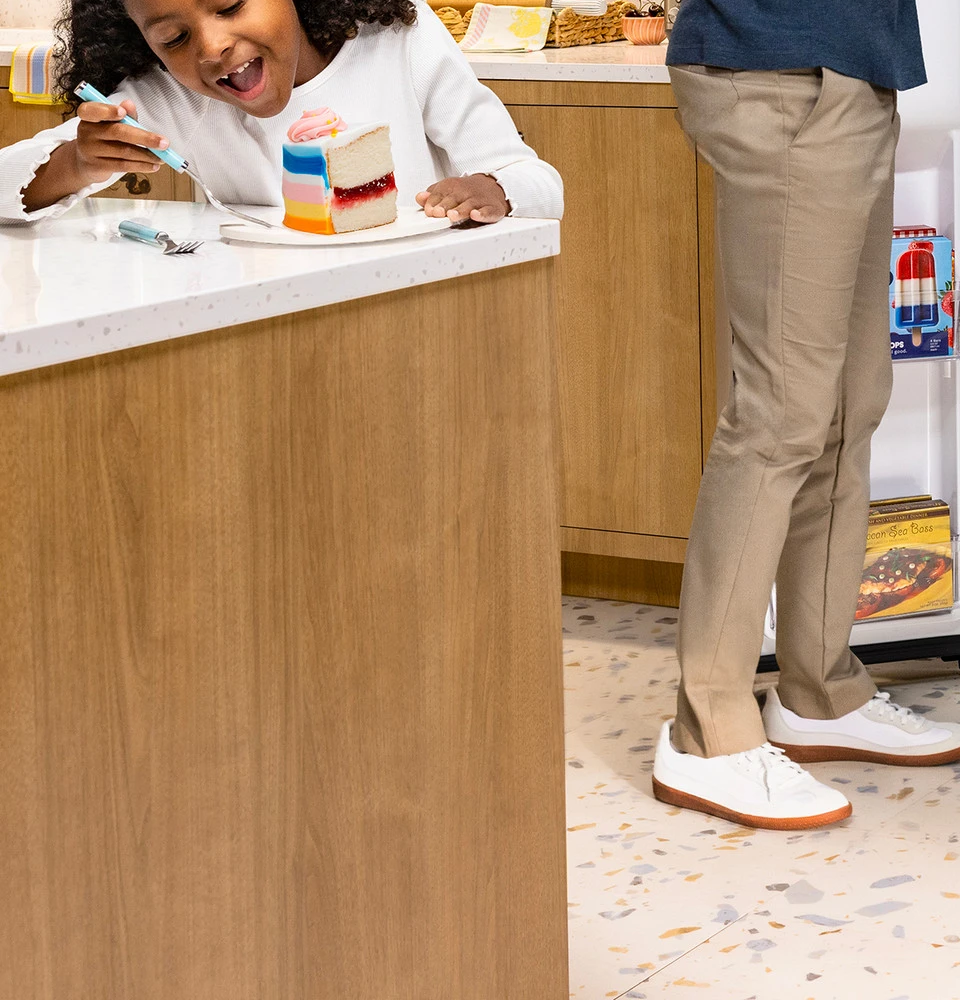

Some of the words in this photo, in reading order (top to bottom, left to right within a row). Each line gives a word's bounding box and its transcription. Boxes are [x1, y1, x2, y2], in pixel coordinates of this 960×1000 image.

[890, 341, 904, 349] OPS
[889, 524, 908, 539] Sea
[911, 522, 934, 535] Bass
